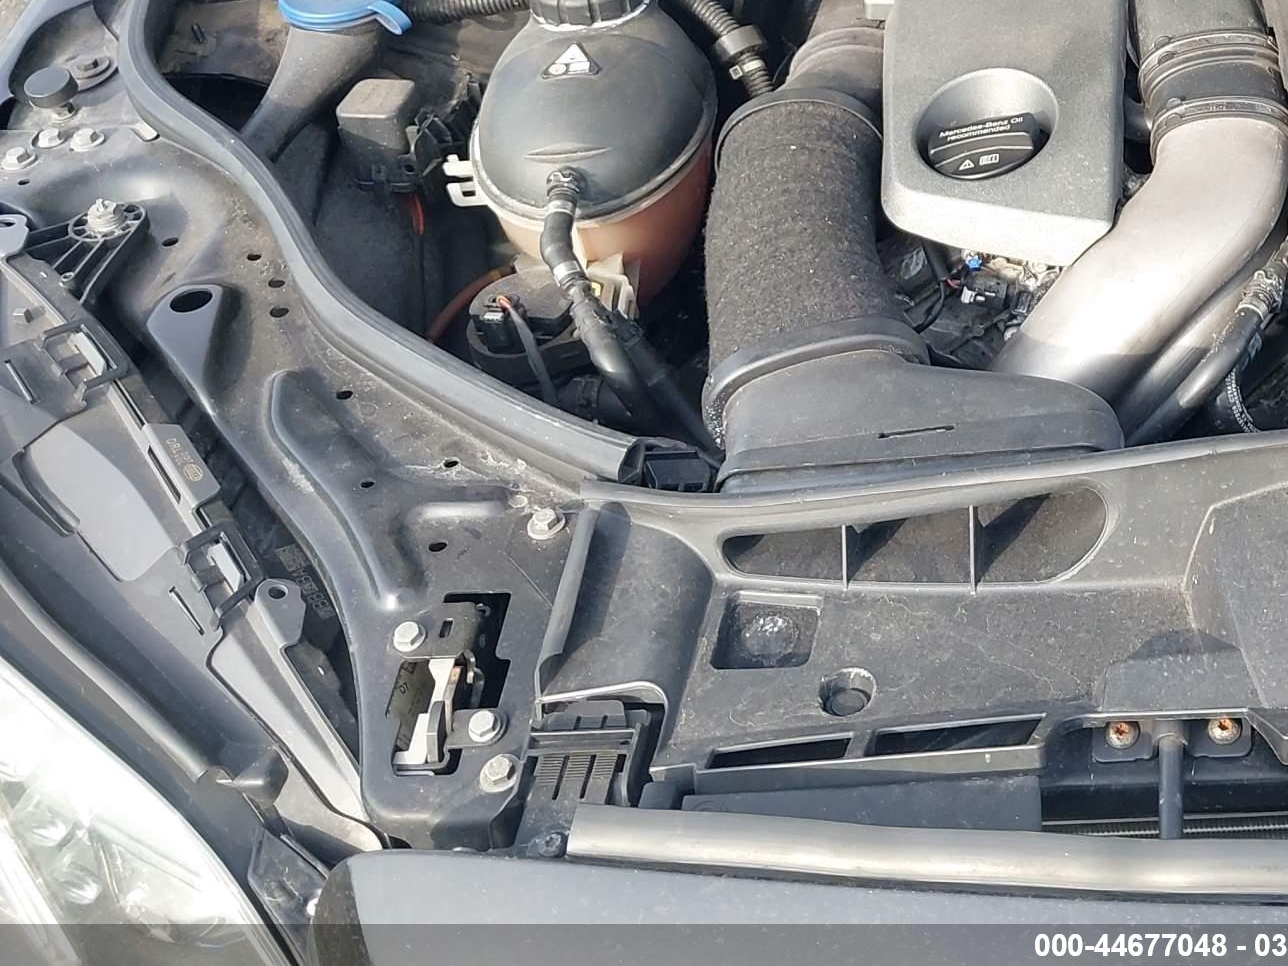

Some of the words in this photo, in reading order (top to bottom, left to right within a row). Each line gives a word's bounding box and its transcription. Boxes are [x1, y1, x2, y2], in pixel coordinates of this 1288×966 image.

[940, 119, 1008, 138] Mercedes-Benz
[1010, 116, 1023, 124] Oil
[947, 125, 1010, 141] recommended
